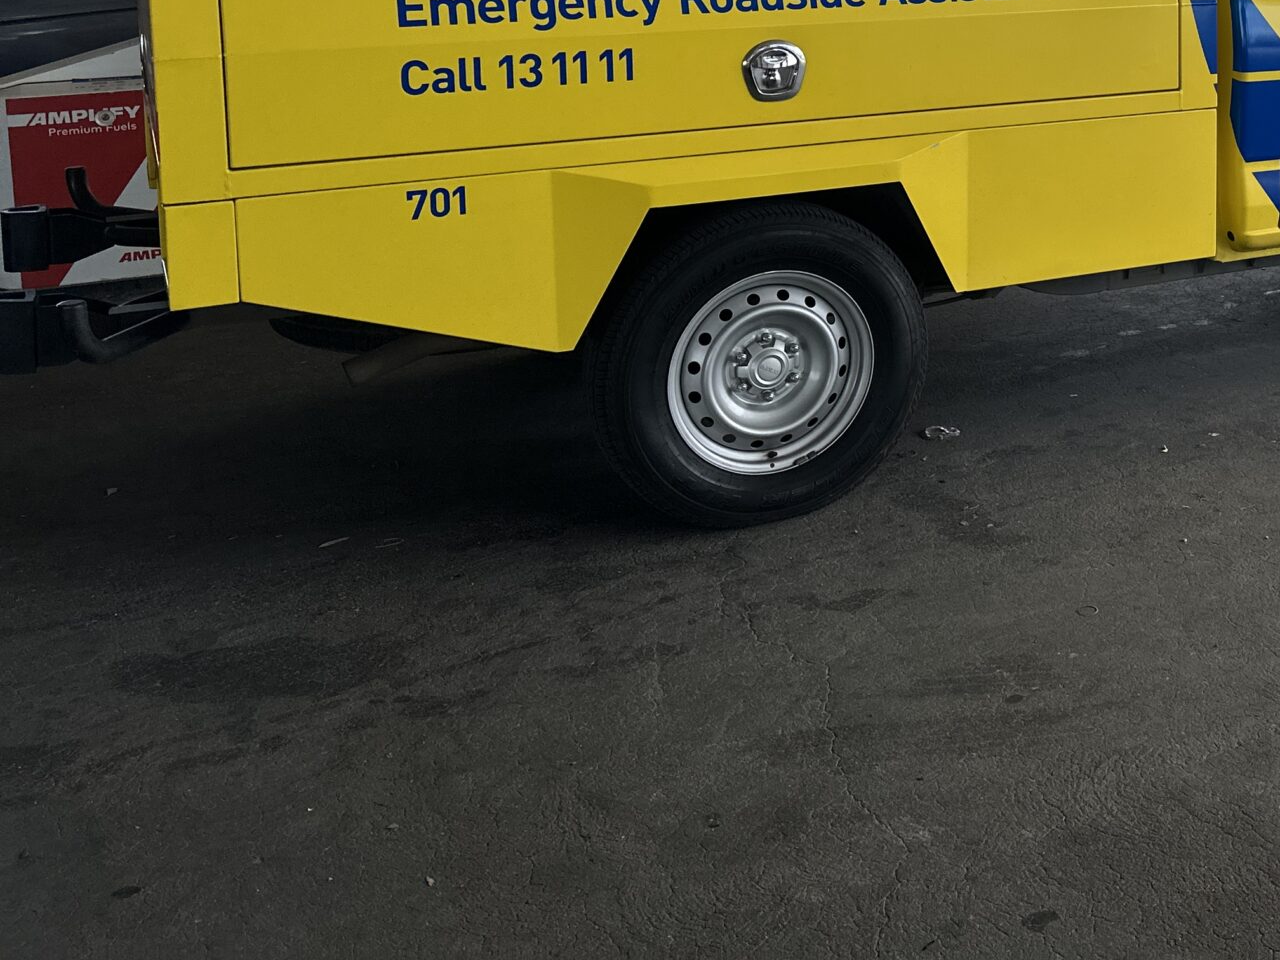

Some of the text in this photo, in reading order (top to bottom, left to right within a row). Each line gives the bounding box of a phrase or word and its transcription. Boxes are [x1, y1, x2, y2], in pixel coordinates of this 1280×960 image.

[400, 48, 636, 96] Call 13 11 11
[48, 126, 103, 137] Premium
[405, 186, 469, 222] 701
